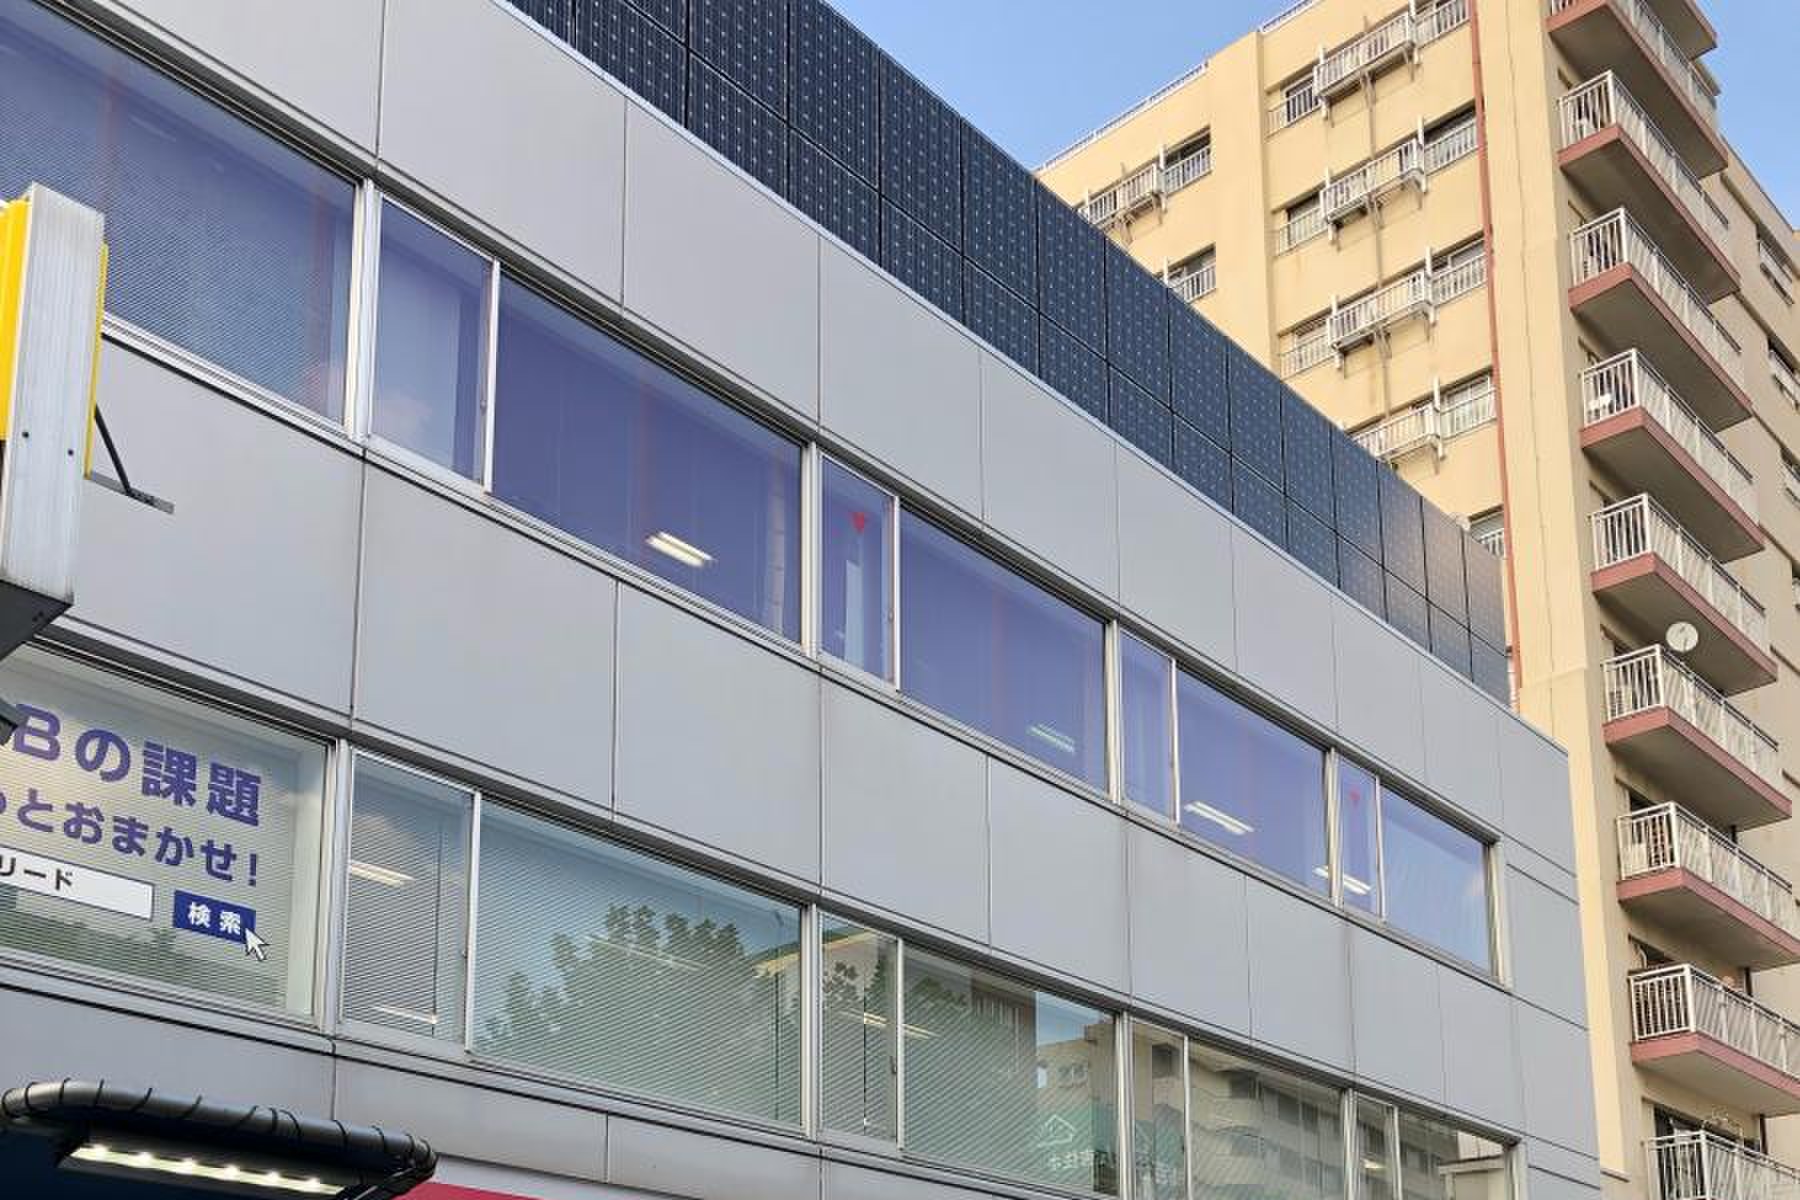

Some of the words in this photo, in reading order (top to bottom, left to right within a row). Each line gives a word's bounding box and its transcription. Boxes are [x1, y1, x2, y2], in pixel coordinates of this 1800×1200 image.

[0, 788, 257, 886] とおまかせ!
[188, 902, 242, 935] 検索
